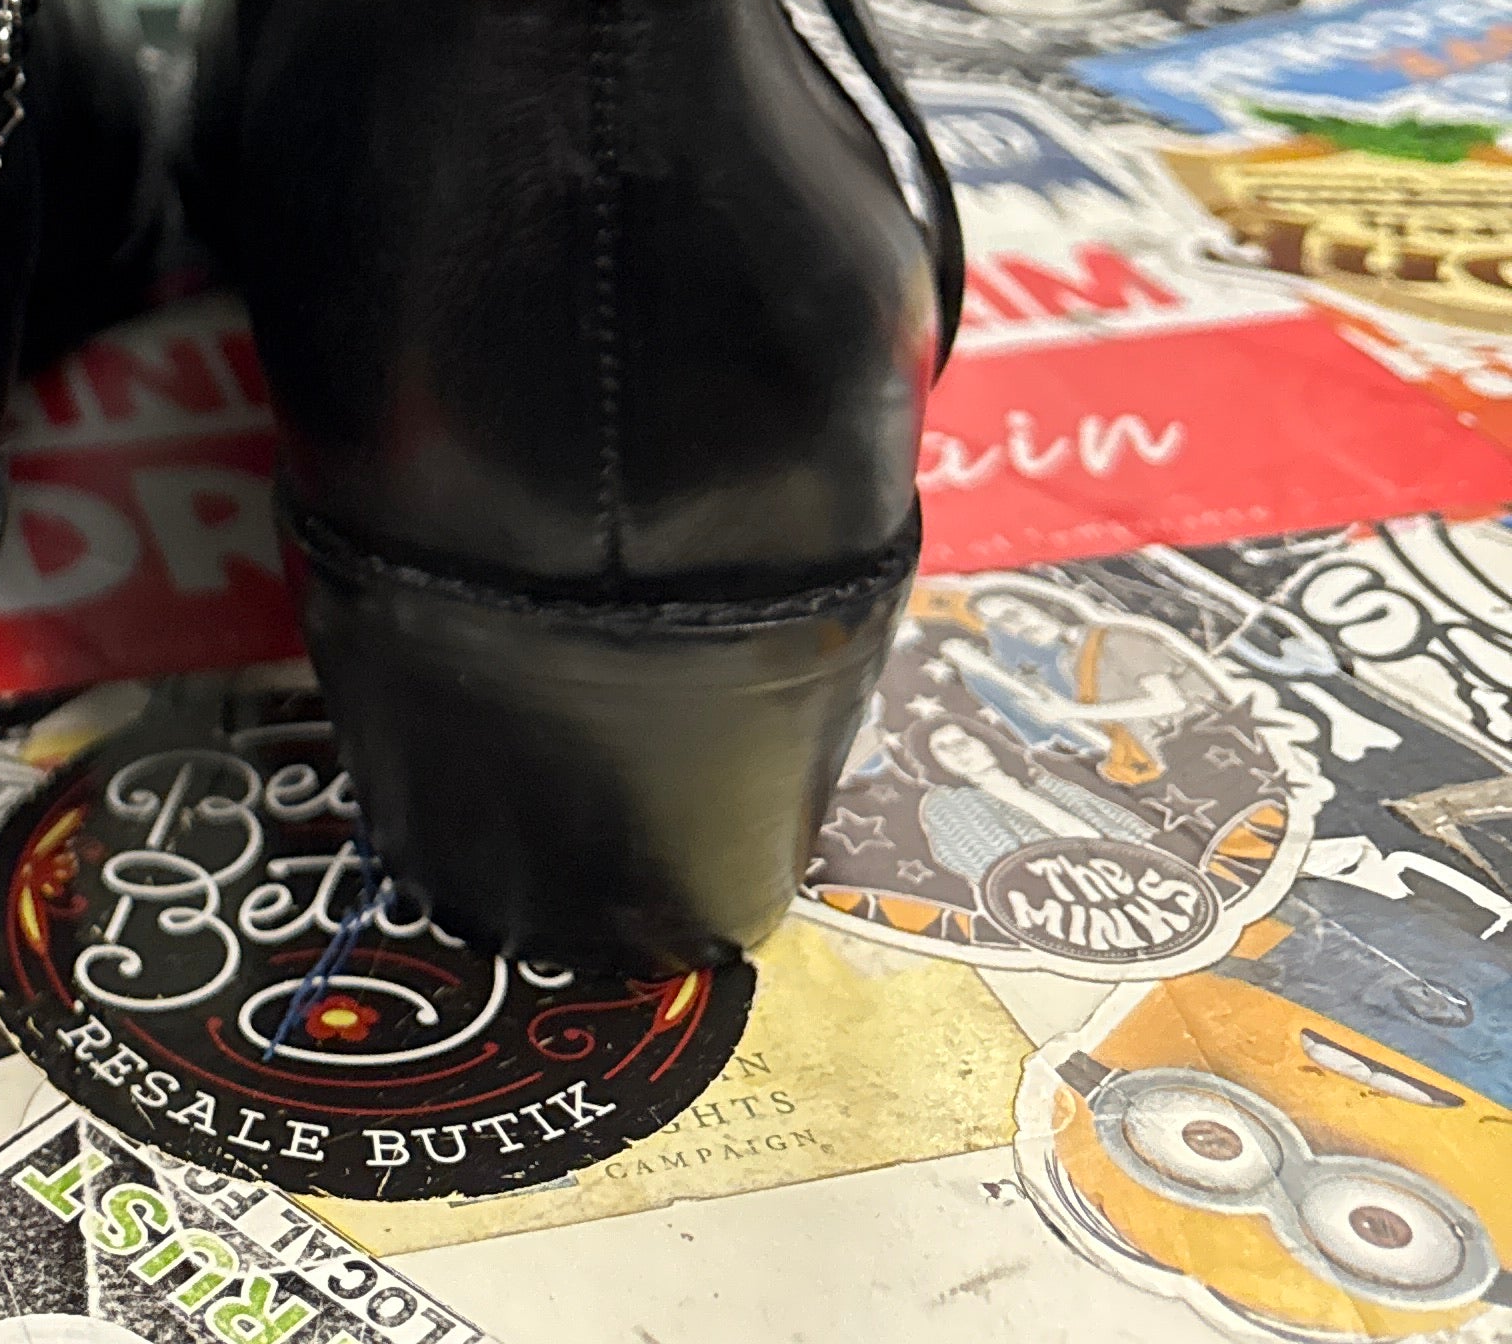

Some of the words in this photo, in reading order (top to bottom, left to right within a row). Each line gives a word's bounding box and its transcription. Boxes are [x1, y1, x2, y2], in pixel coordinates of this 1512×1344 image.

[1025, 855, 1134, 902] The
[57, 1013, 326, 1162] RESALE
[362, 1079, 616, 1167] BUTIK
[604, 1128, 819, 1180] CAMPAIGN
